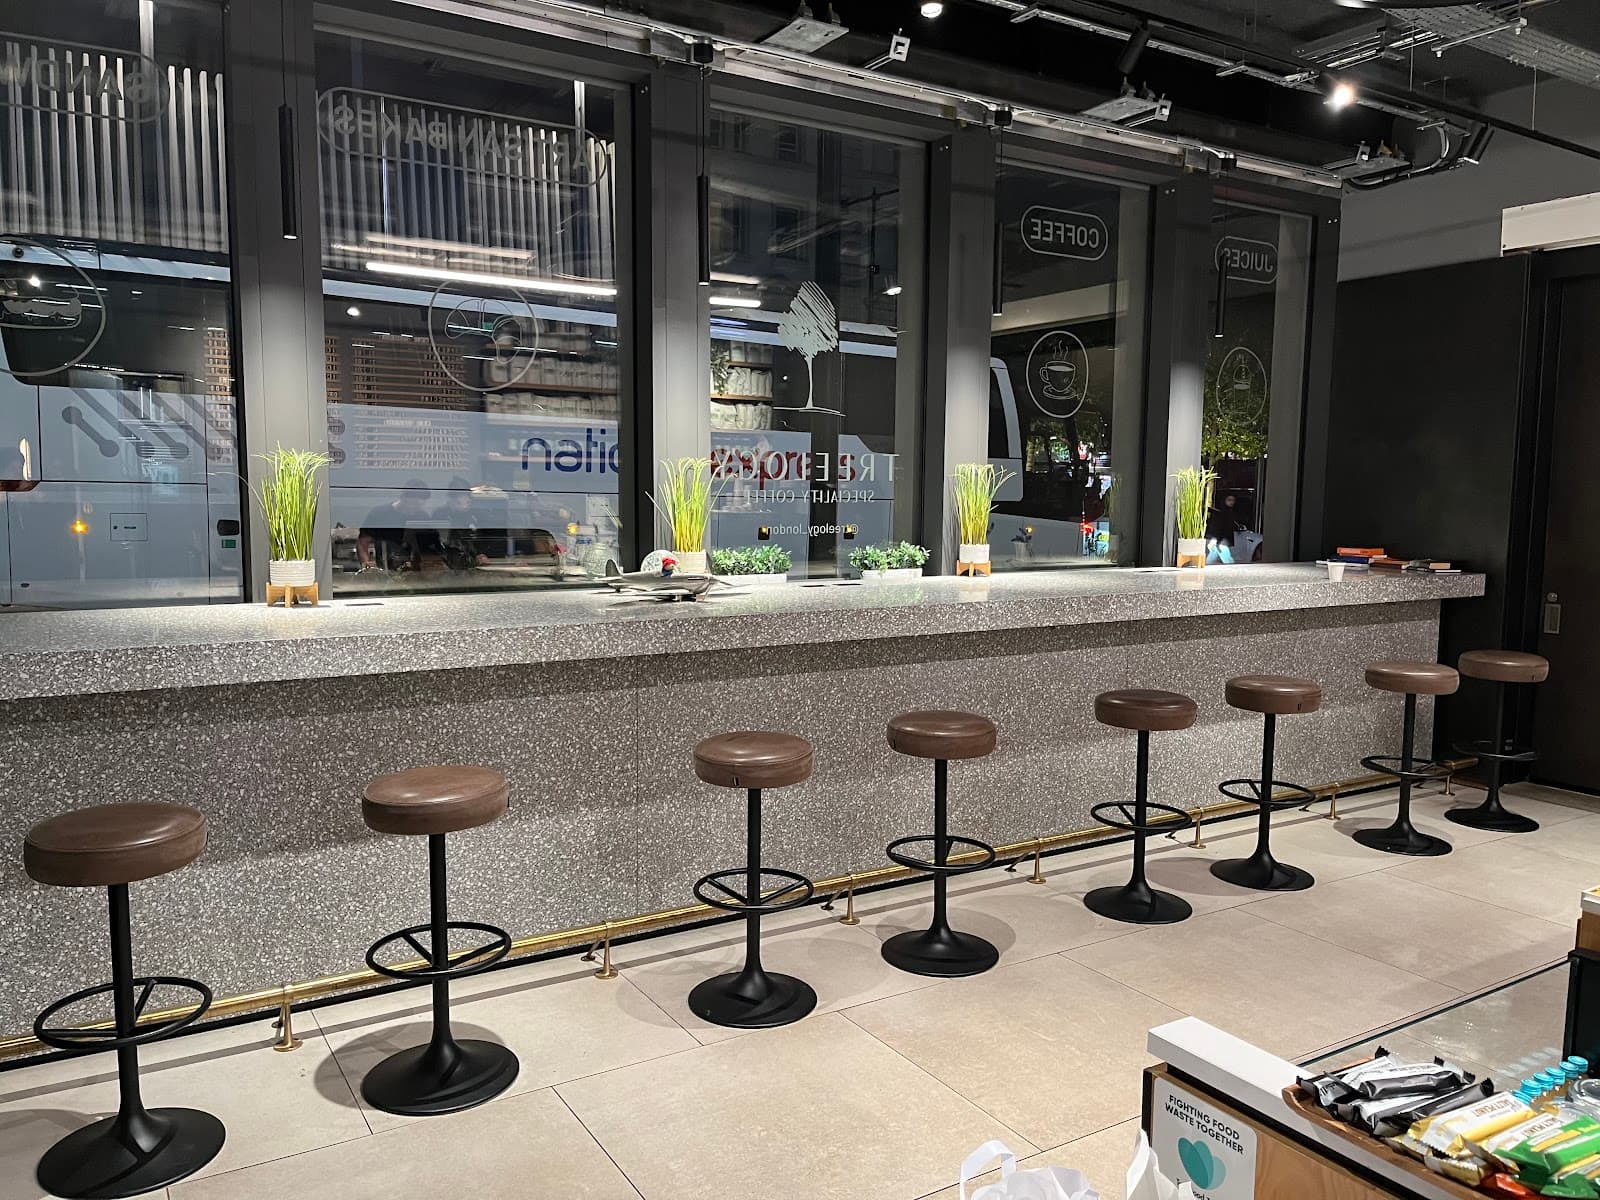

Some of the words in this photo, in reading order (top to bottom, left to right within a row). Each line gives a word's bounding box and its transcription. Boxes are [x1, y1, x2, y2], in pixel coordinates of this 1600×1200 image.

[1165, 1102, 1195, 1126] WASTE
[1195, 1120, 1244, 1155] TOGETHER
[1169, 1094, 1211, 1124] FIGHTING
[1212, 1118, 1240, 1141] FOOD
